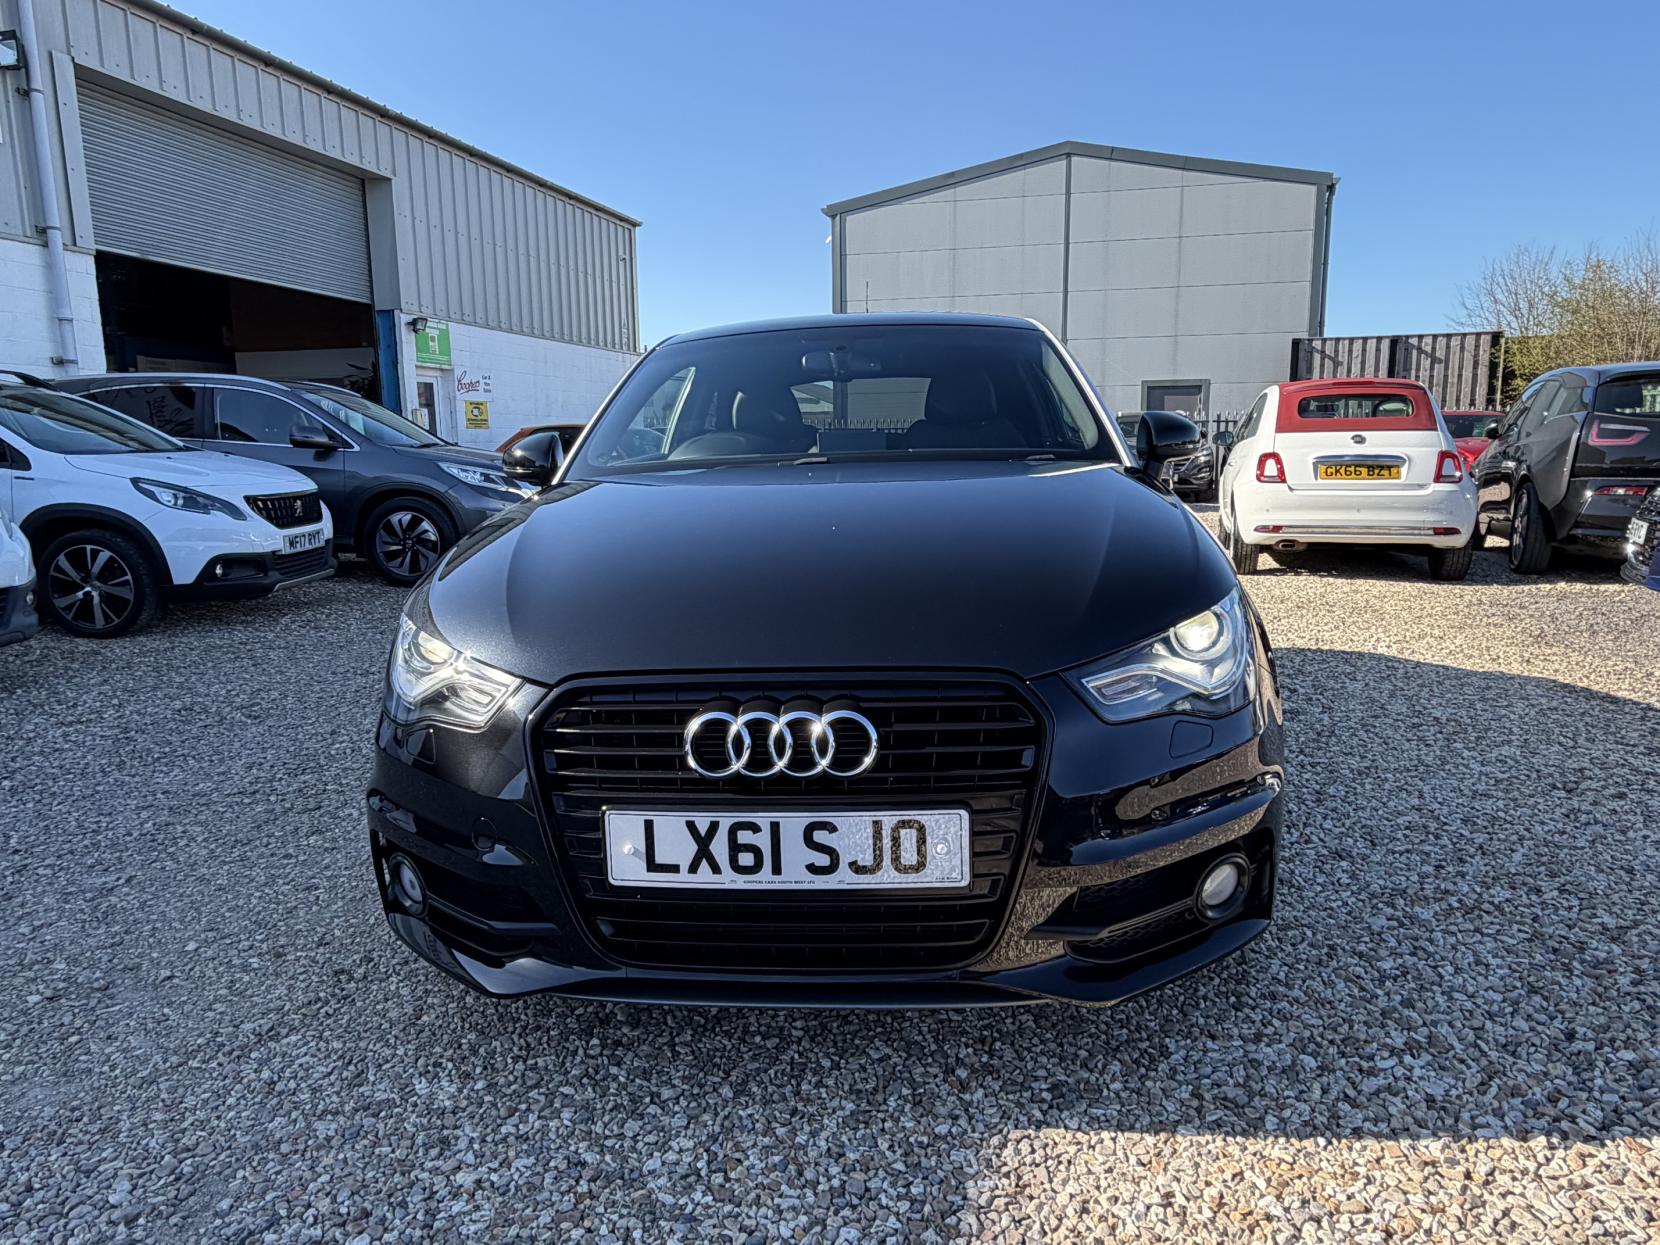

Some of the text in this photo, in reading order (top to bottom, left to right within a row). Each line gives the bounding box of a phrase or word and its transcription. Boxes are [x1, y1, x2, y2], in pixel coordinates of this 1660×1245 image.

[1325, 465, 1393, 477] GK66 BZT
[307, 531, 320, 547] RYT
[644, 818, 929, 877] LX61 SJO
